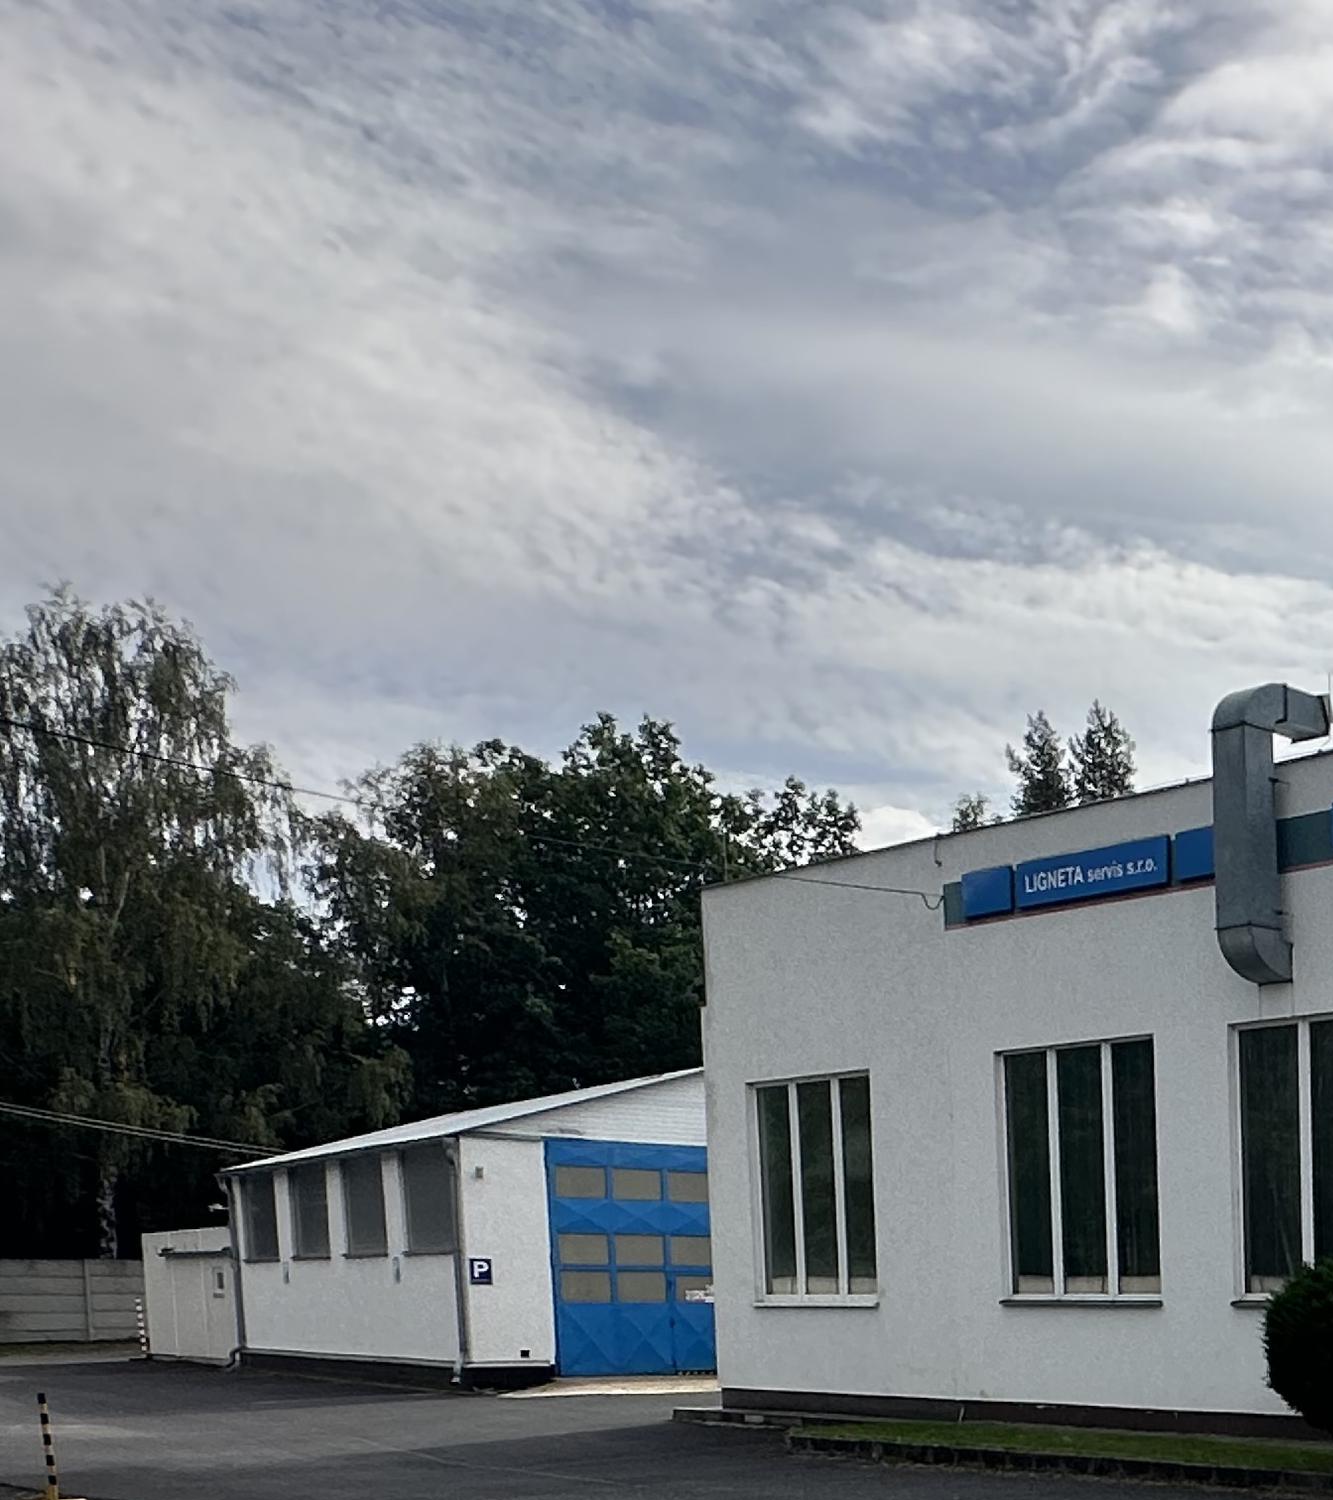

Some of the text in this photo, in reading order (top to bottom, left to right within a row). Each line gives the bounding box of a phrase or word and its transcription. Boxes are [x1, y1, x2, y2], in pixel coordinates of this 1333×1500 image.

[1024, 858, 1158, 893] LIGNETA servis s.r.o.
[473, 1260, 489, 1278] P
